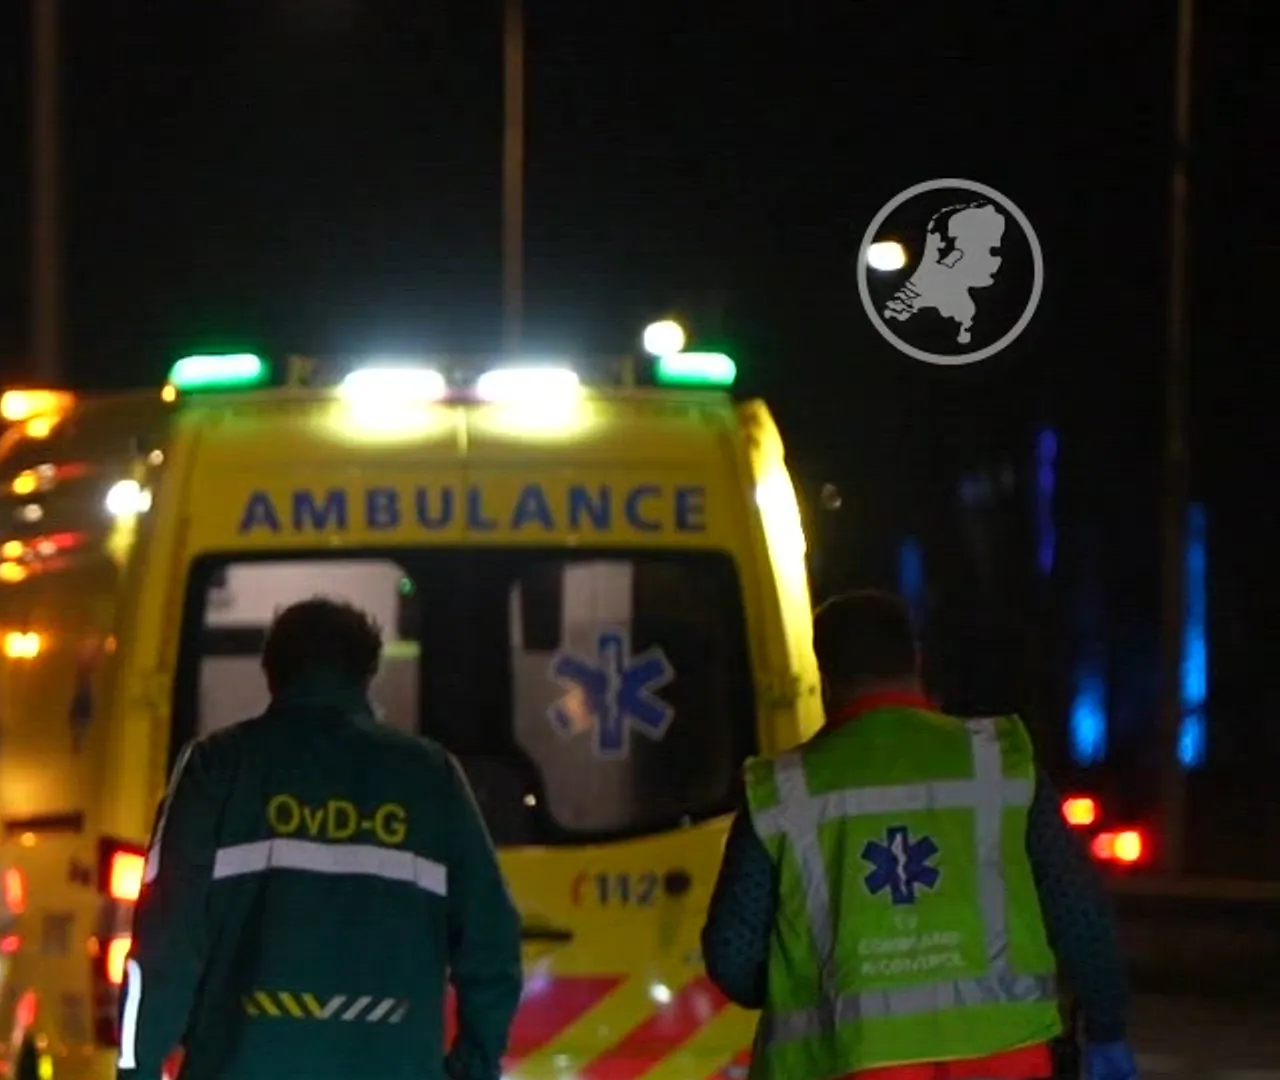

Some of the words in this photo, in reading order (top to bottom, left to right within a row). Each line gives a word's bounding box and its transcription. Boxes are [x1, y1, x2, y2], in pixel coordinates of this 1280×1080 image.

[239, 482, 706, 535] AMBULANCE
[266, 792, 410, 846] OvD-G
[594, 872, 659, 907] 112
